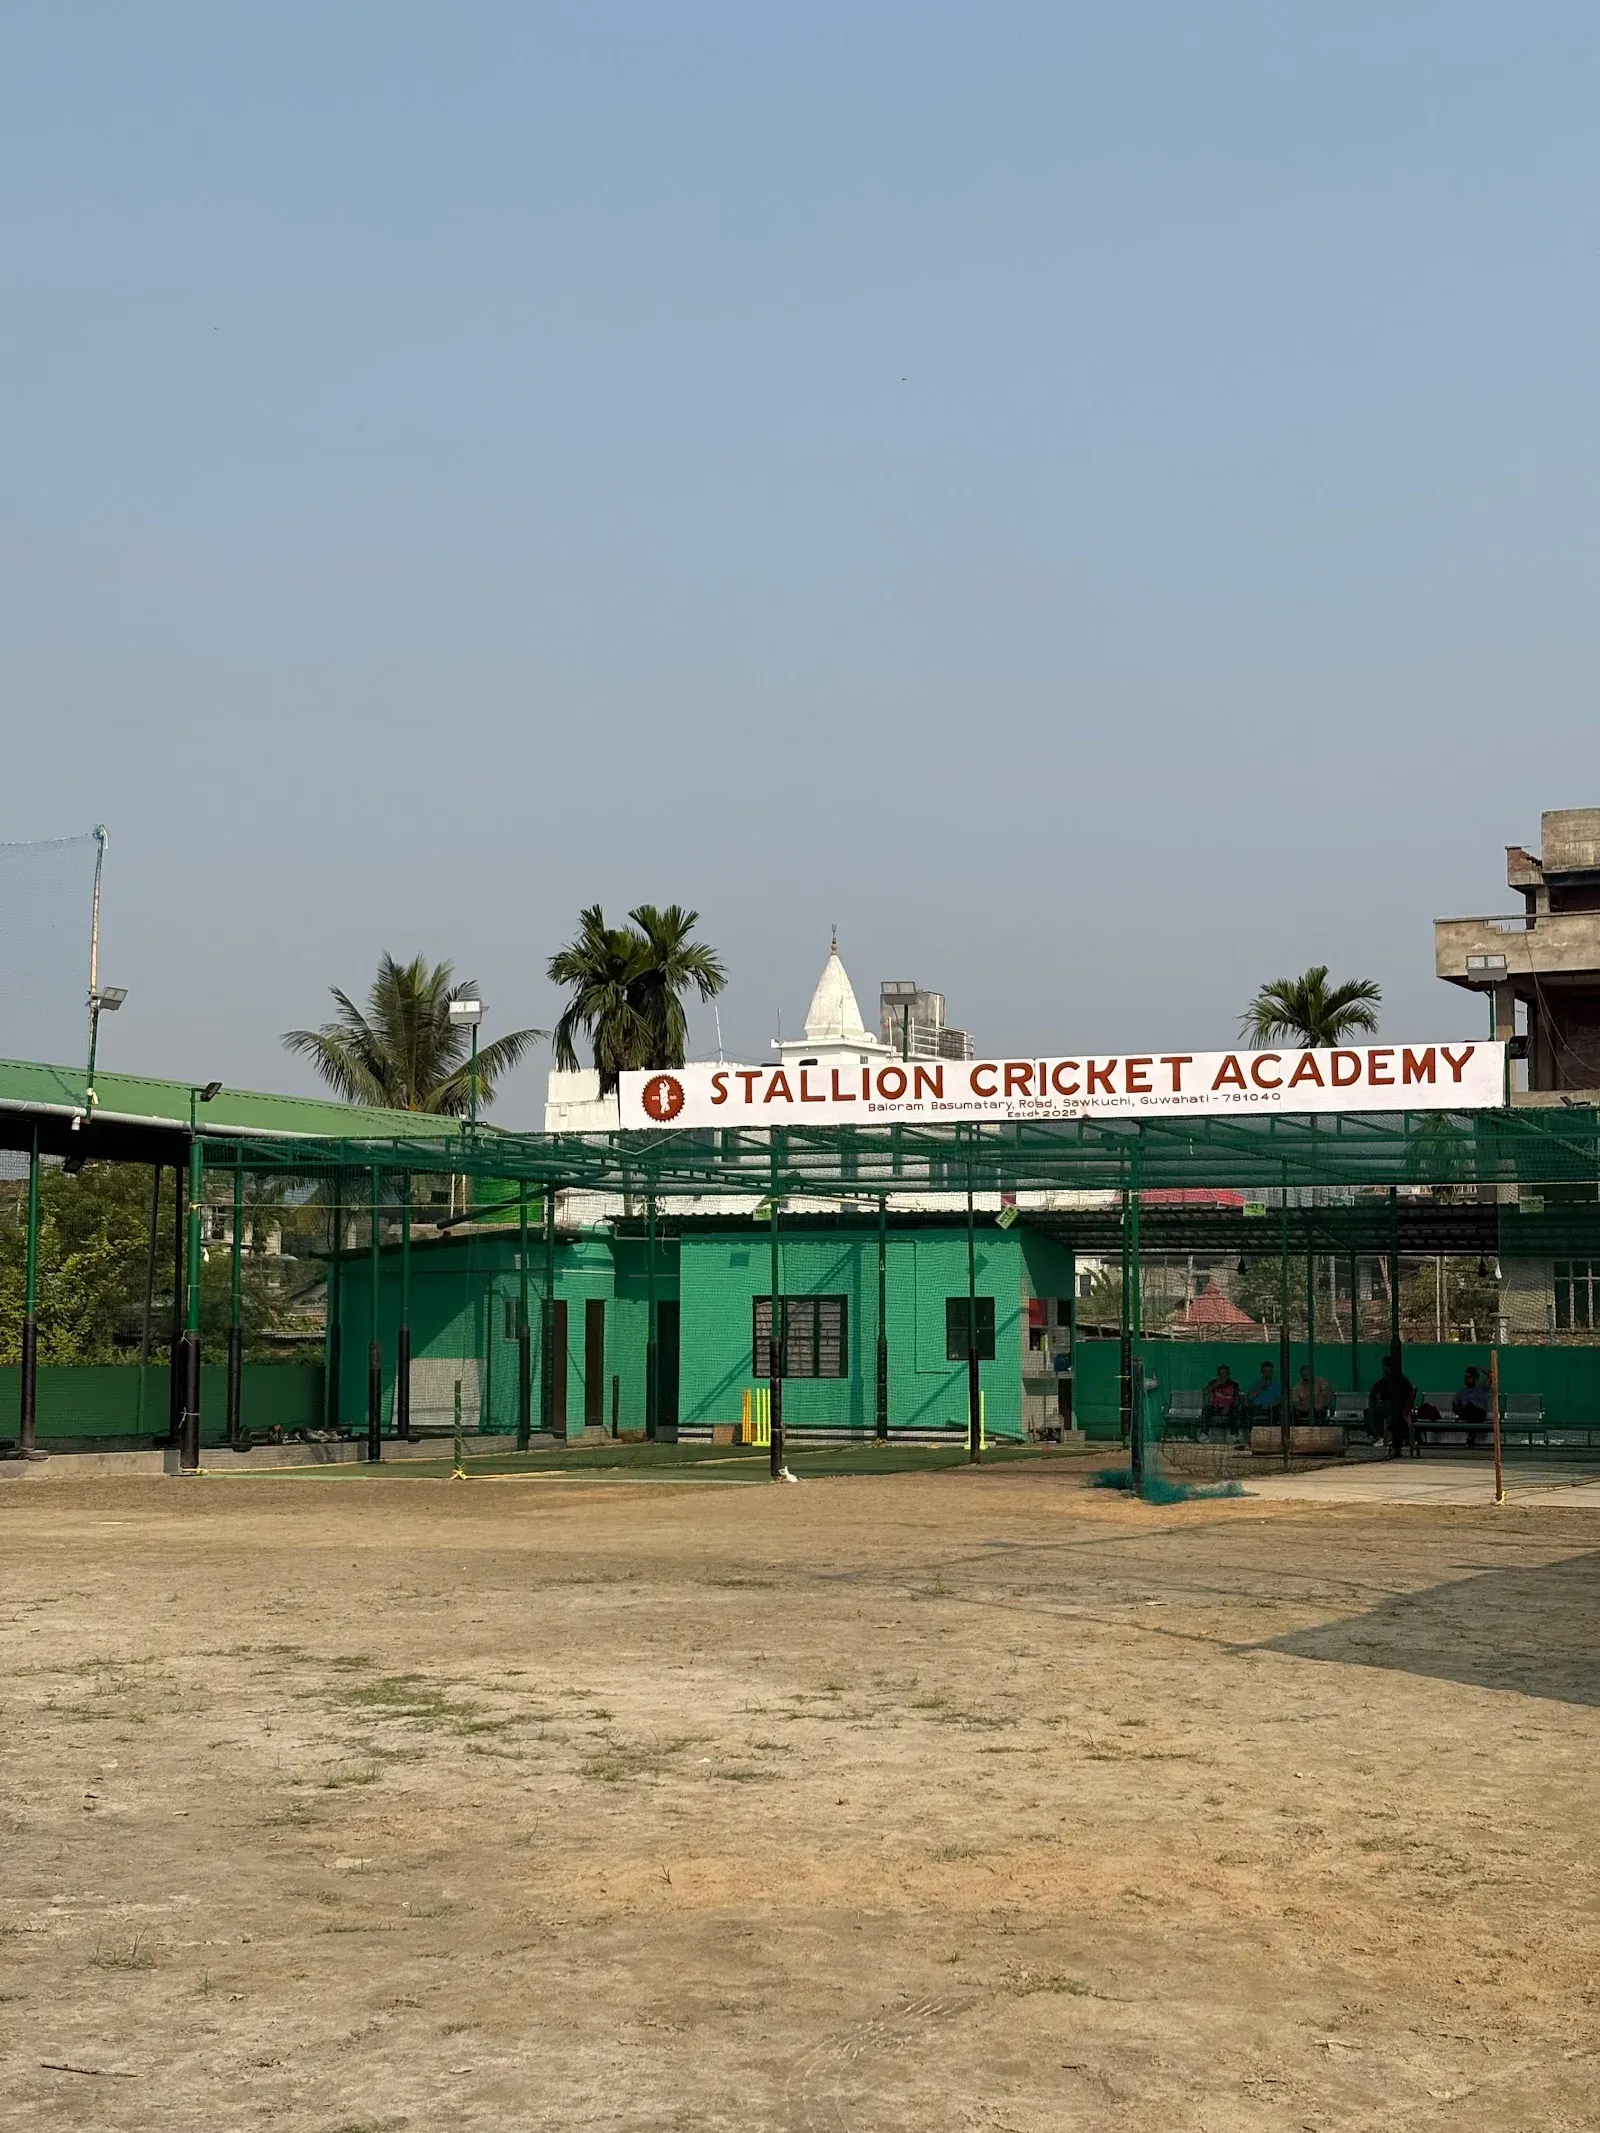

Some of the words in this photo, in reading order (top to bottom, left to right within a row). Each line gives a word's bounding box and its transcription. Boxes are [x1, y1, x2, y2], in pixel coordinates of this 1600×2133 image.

[711, 1065, 944, 1104] STALLION
[970, 1057, 1192, 1097] CRICKET
[1211, 1047, 1474, 1090] ACADEMY
[868, 1103, 924, 1112] Baloram
